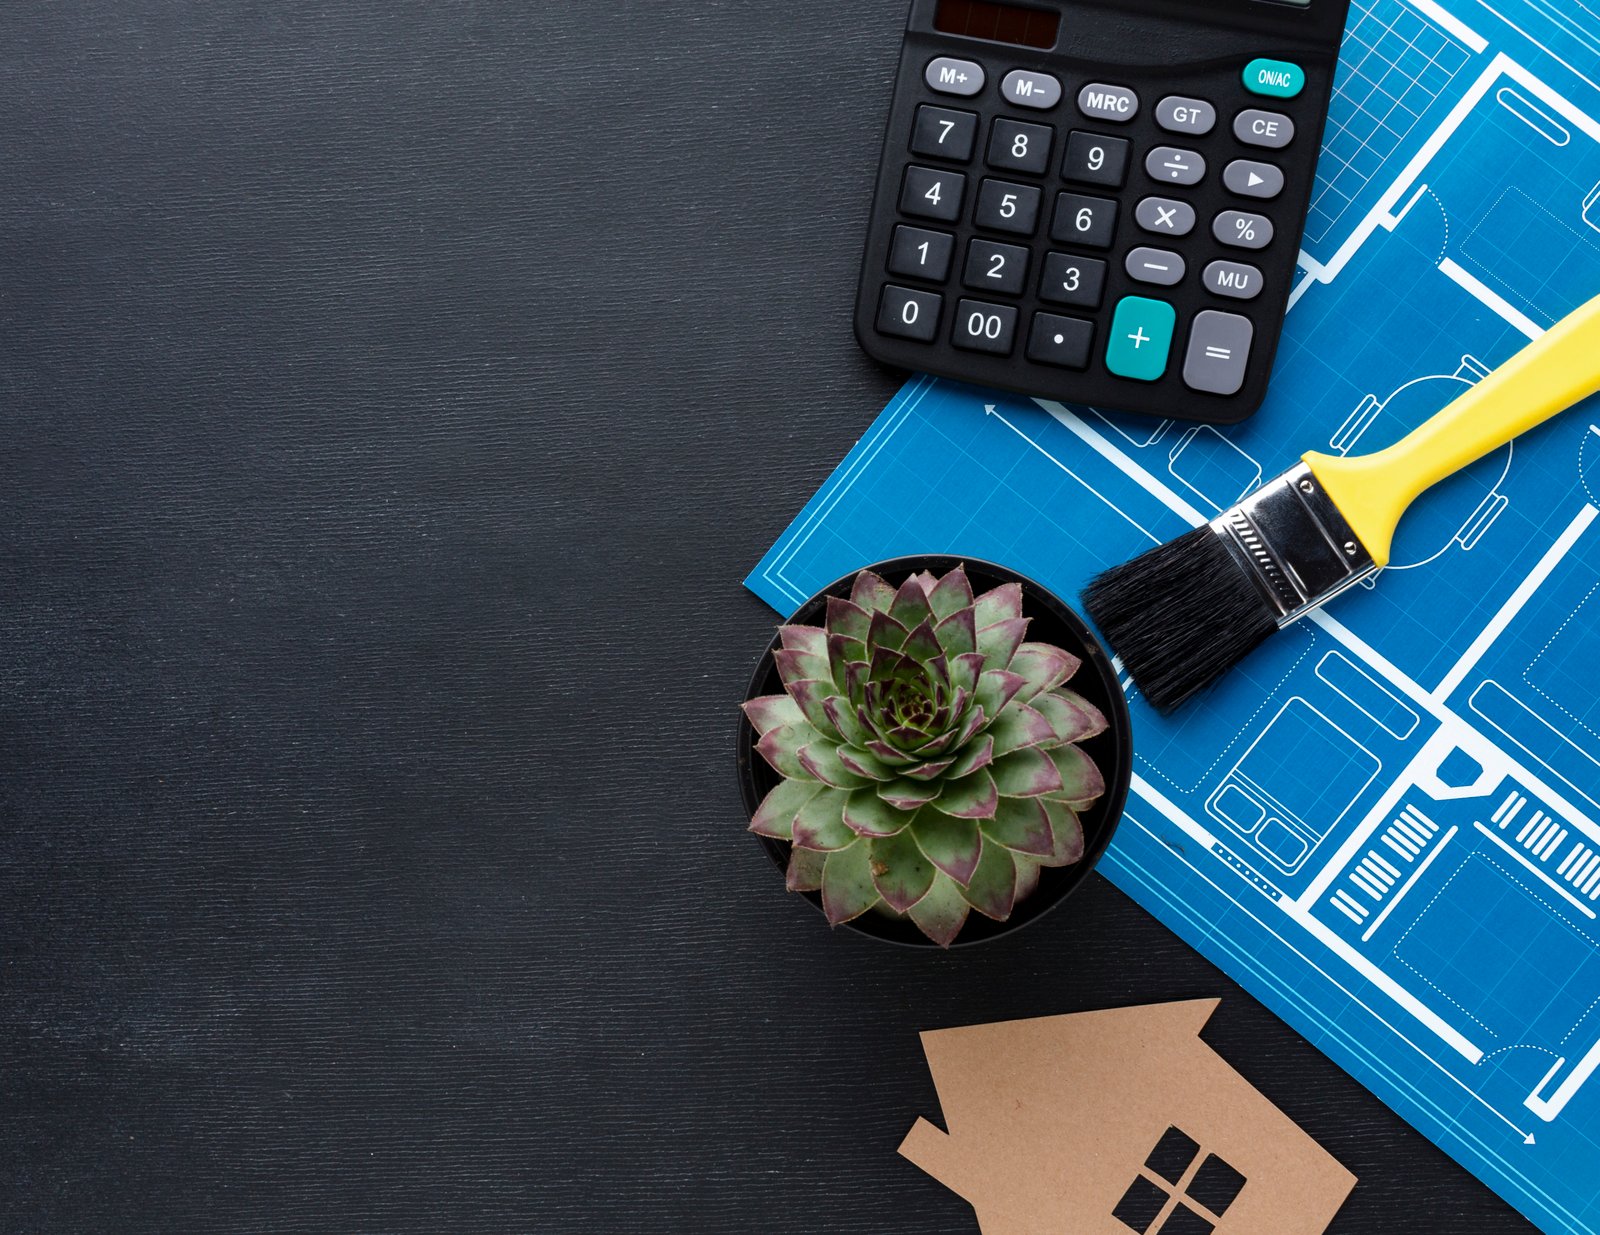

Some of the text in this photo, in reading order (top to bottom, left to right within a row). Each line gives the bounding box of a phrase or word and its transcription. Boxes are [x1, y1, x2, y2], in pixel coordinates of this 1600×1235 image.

[938, 66, 969, 85] M+
[1257, 68, 1292, 89] ON/AC
[1086, 91, 1130, 113] MRC
[1172, 105, 1203, 126] GT
[1251, 118, 1280, 138] CE
[937, 119, 956, 145] 7
[1011, 133, 1029, 158] 8
[1087, 146, 1105, 171] 9
[923, 180, 942, 206] 4
[998, 193, 1018, 219] 5
[1074, 206, 1094, 233] 6
[1234, 217, 1256, 242] %
[917, 241, 930, 266] 1
[986, 254, 1006, 280] 2
[1062, 267, 1081, 292] 3
[1216, 269, 1250, 291] MU
[901, 300, 920, 326] 0
[966, 311, 1003, 340] 00
